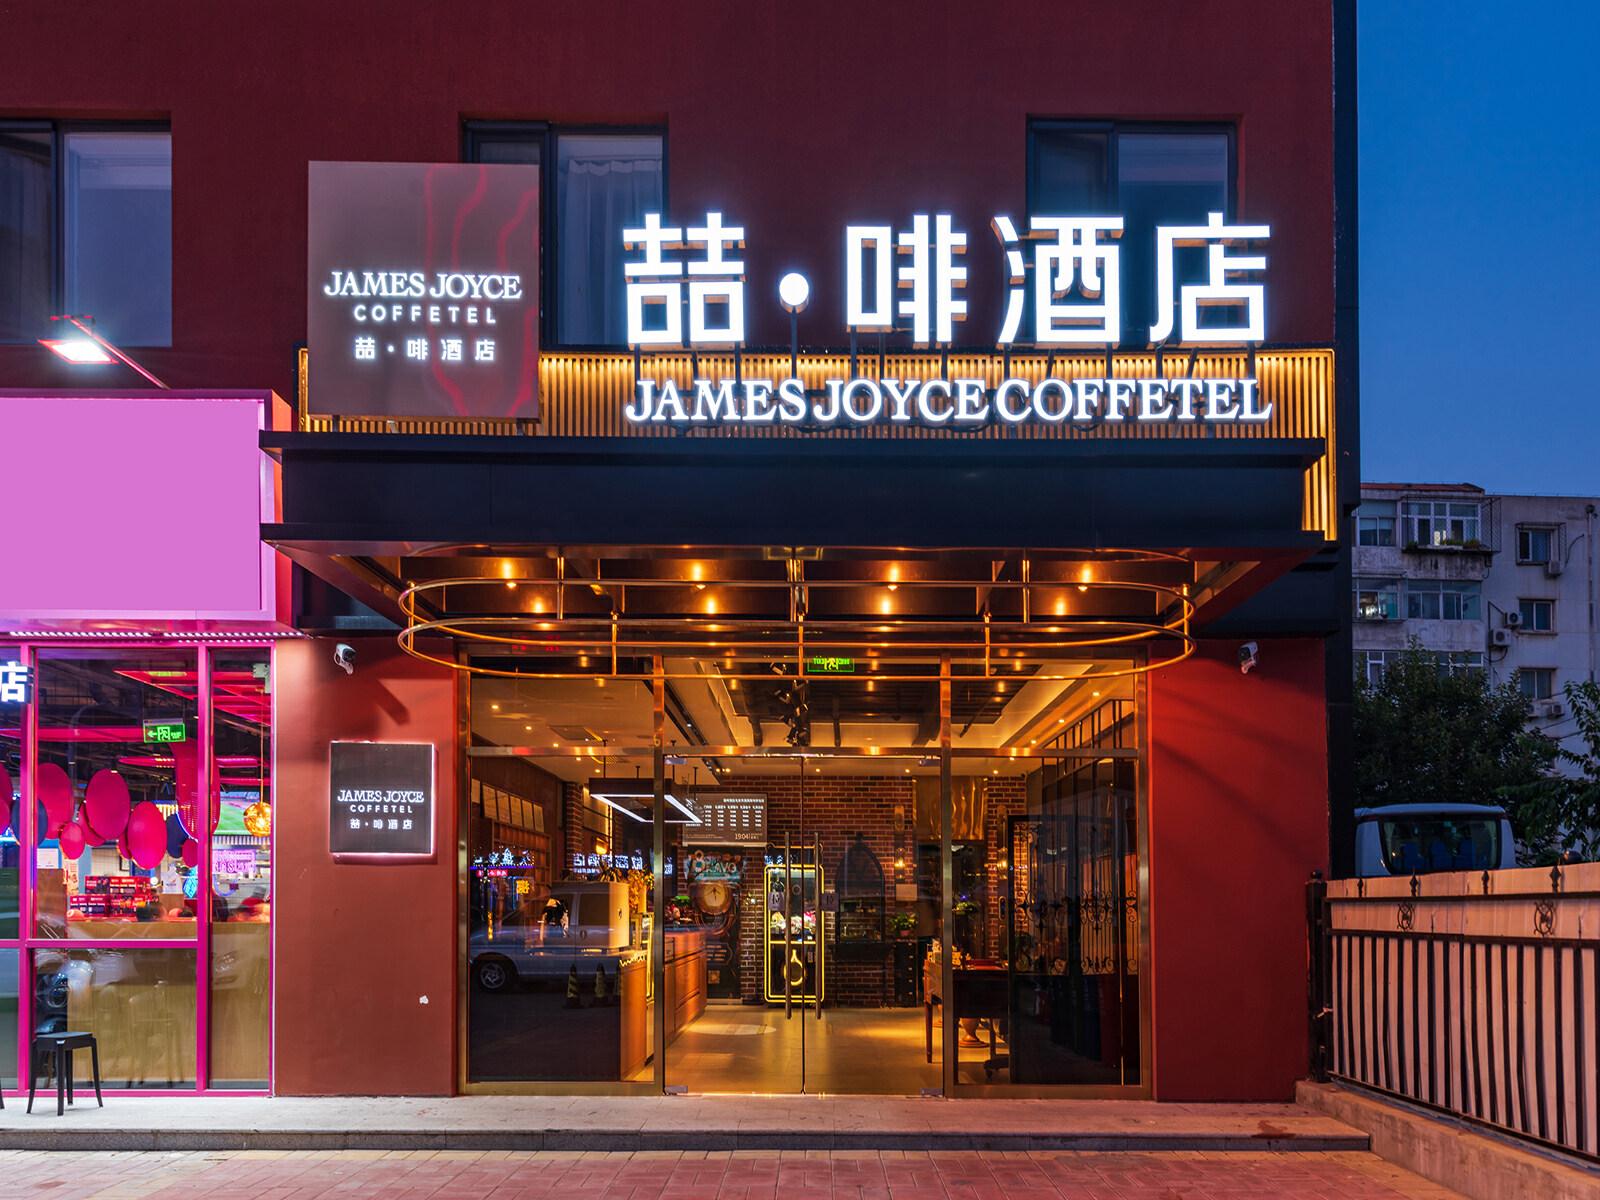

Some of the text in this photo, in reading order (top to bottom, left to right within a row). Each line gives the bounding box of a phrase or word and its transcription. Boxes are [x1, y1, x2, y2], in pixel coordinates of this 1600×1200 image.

[324, 271, 524, 299] JAMES JOYCE
[623, 212, 1270, 344] 喆·啡酒店
[353, 304, 496, 324] COFFETEL
[354, 337, 496, 361] 喆·啡酒店
[625, 378, 1273, 422] JAMES JOYCE COFFETEL
[337, 789, 425, 803] JAMES JOYCE
[349, 804, 413, 813] COFFETEL
